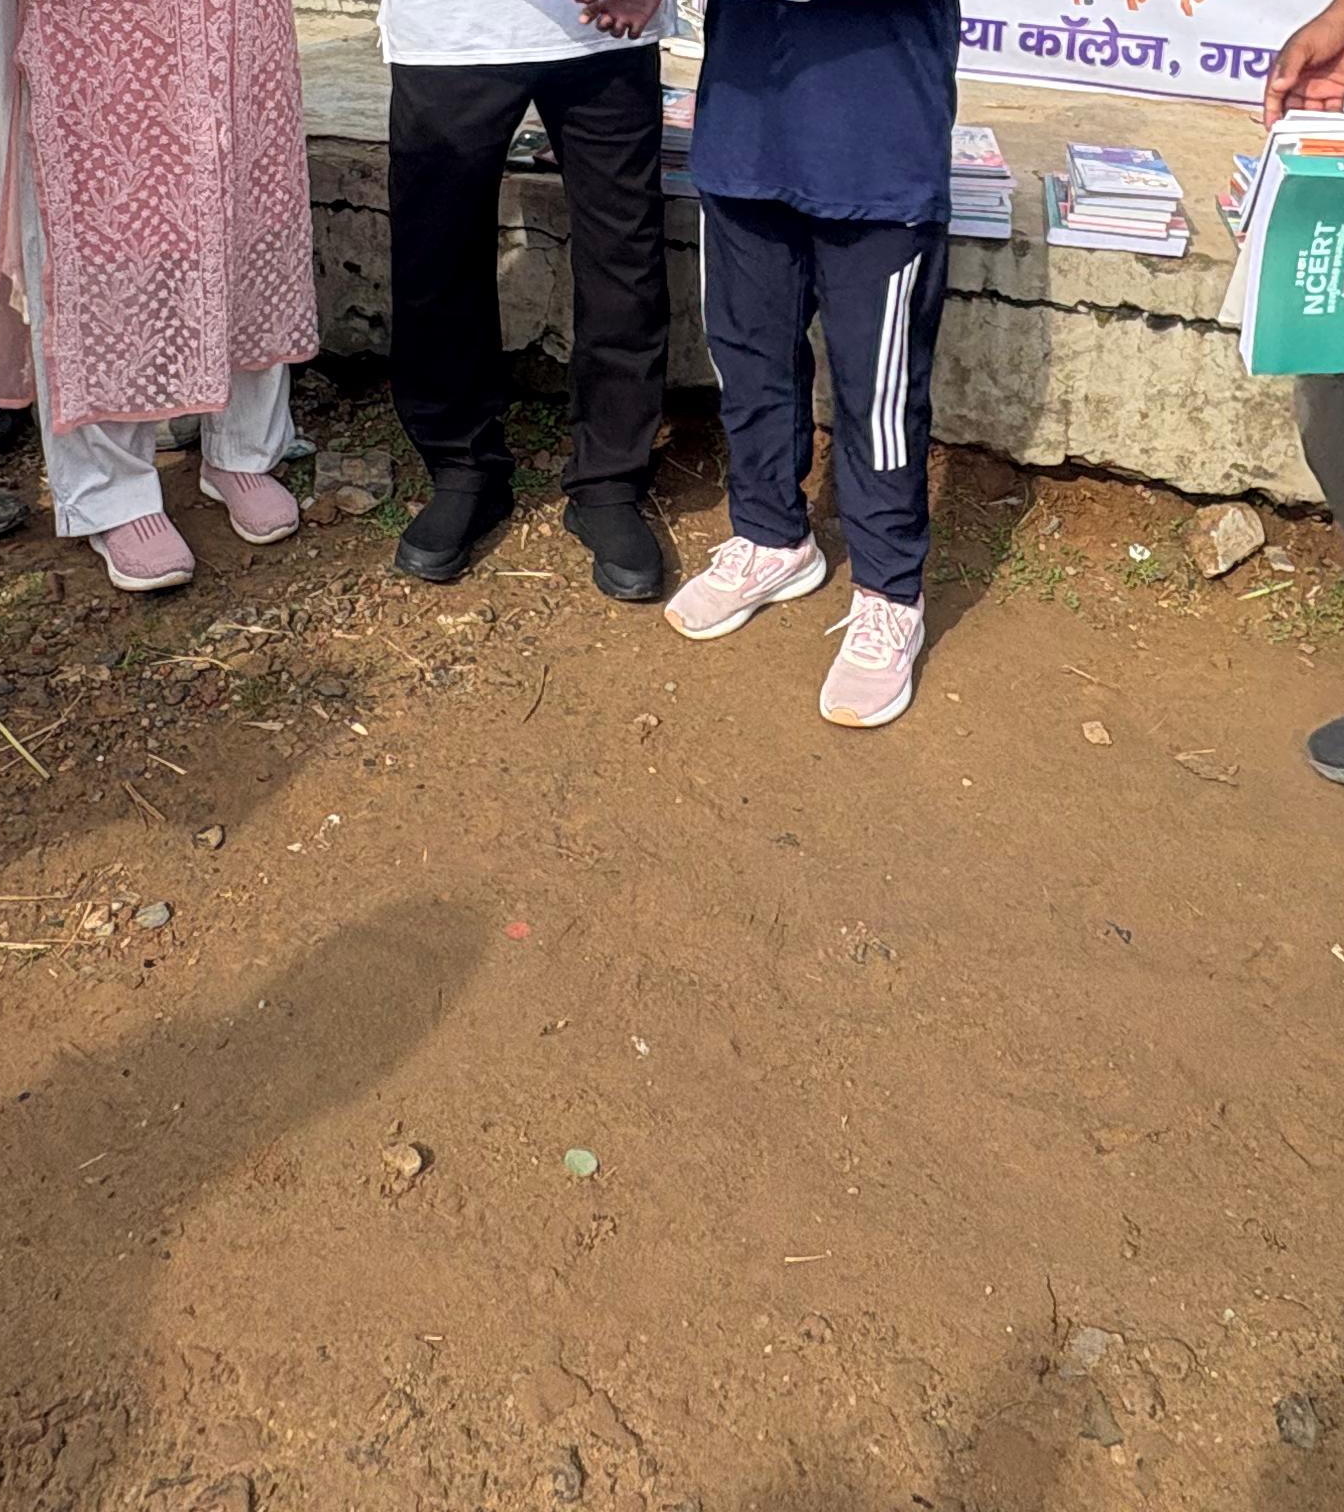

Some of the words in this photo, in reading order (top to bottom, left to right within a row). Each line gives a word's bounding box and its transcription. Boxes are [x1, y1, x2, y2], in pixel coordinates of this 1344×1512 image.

[1018, 15, 1181, 77] कॉलेज,
[1200, 42, 1278, 80] गय
[1303, 221, 1337, 315] NCERT
